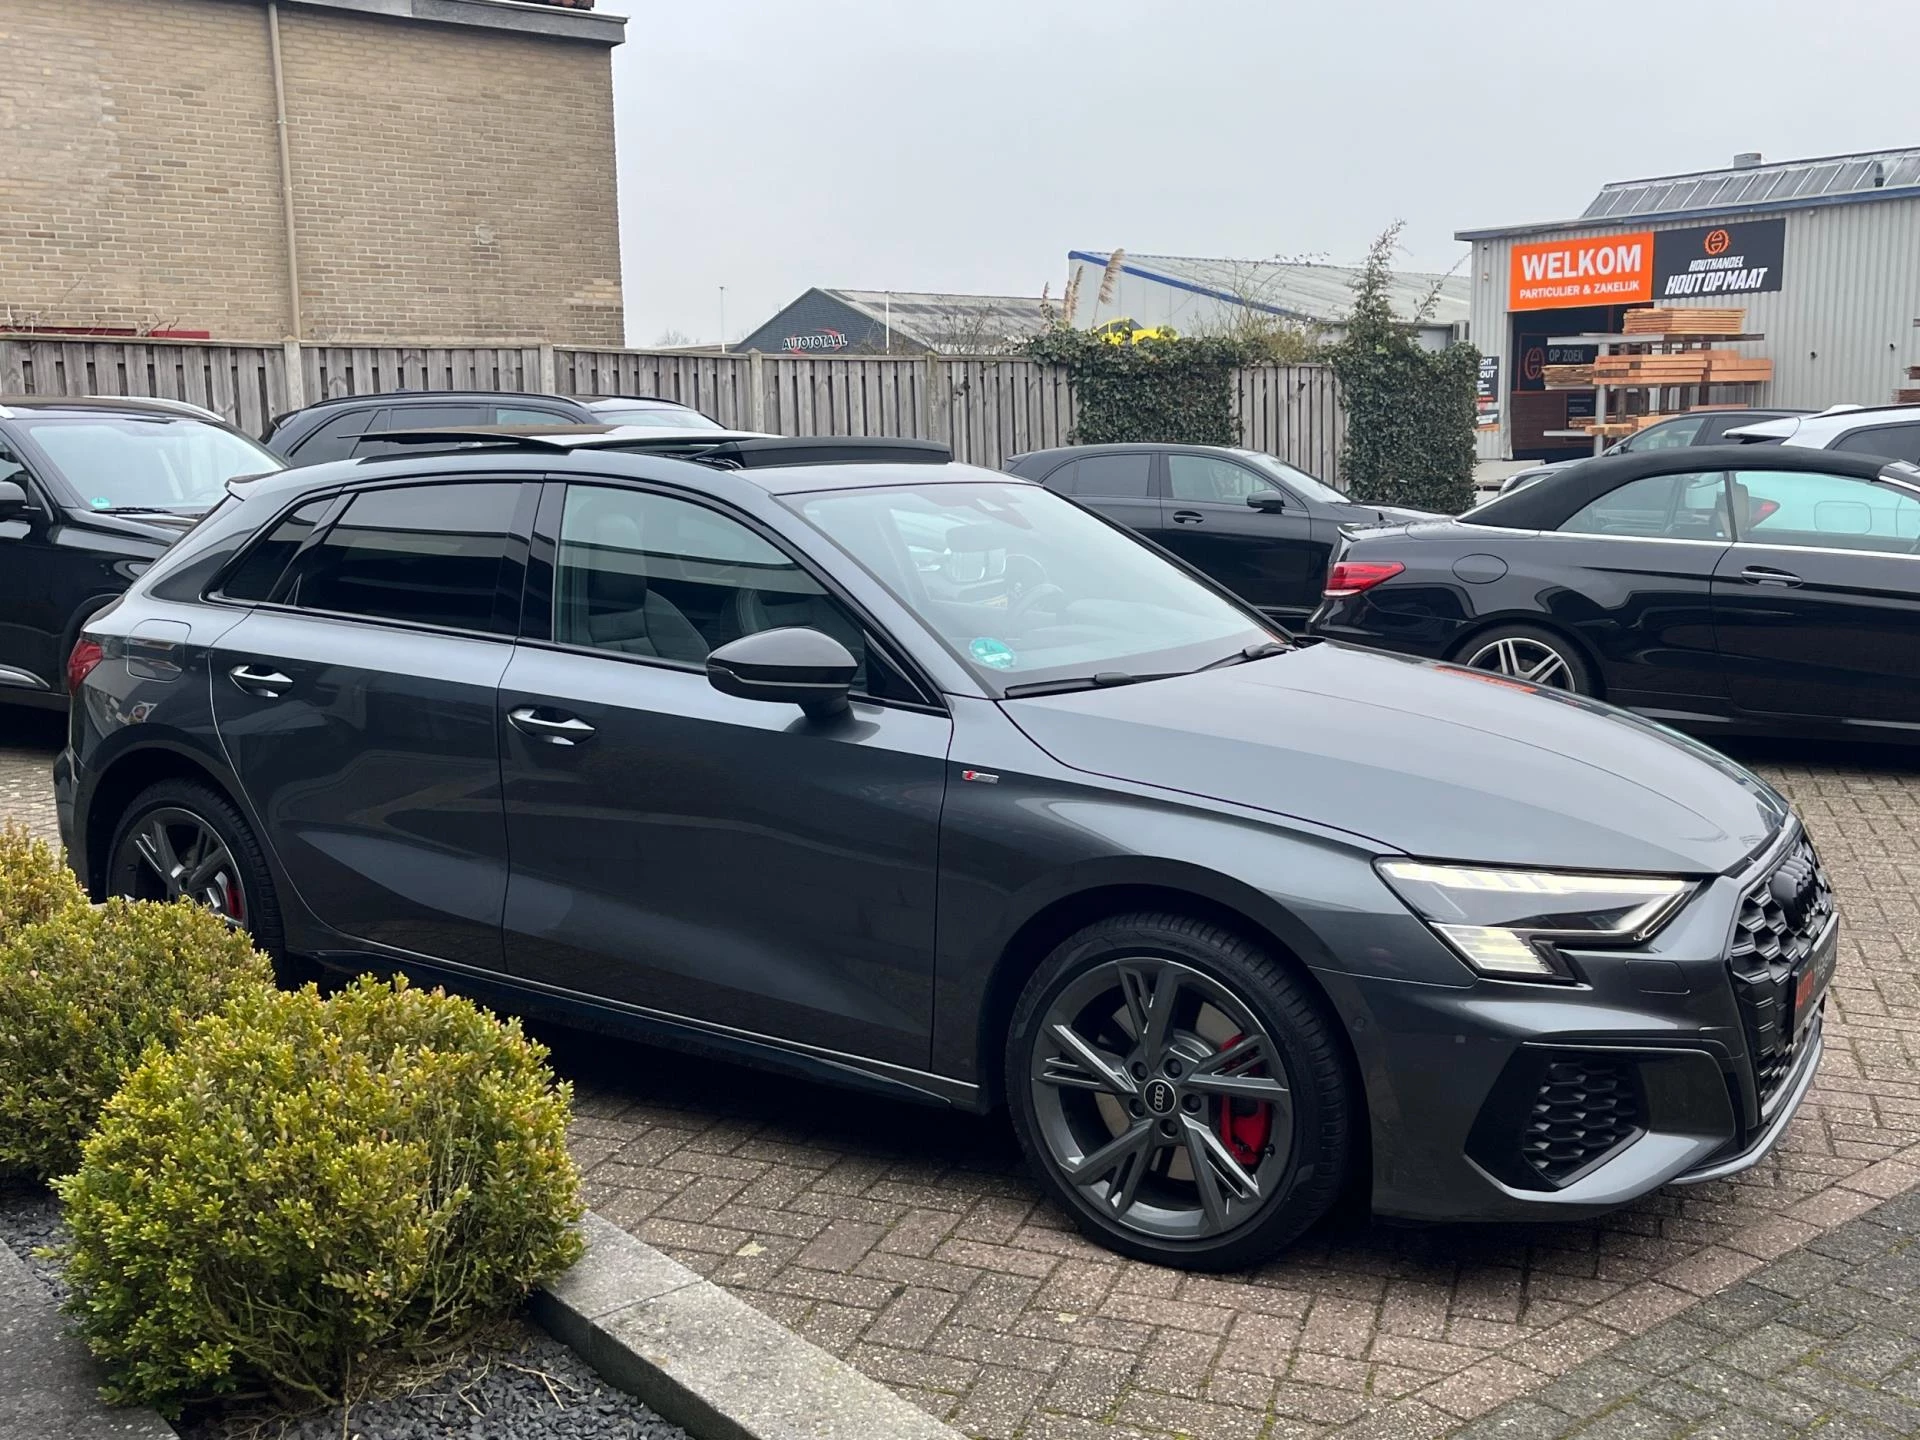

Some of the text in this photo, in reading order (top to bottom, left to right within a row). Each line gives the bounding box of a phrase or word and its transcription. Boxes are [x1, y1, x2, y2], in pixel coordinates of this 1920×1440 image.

[1521, 244, 1641, 281] WELKOM
[1688, 255, 1745, 272] HOUTHANDEL
[1519, 280, 1640, 299] PARTICULIER & ZAKELIJK
[782, 334, 848, 350] AUTOTOTAAL
[1548, 349, 1560, 362] OP
[1479, 370, 1494, 379] OUT
